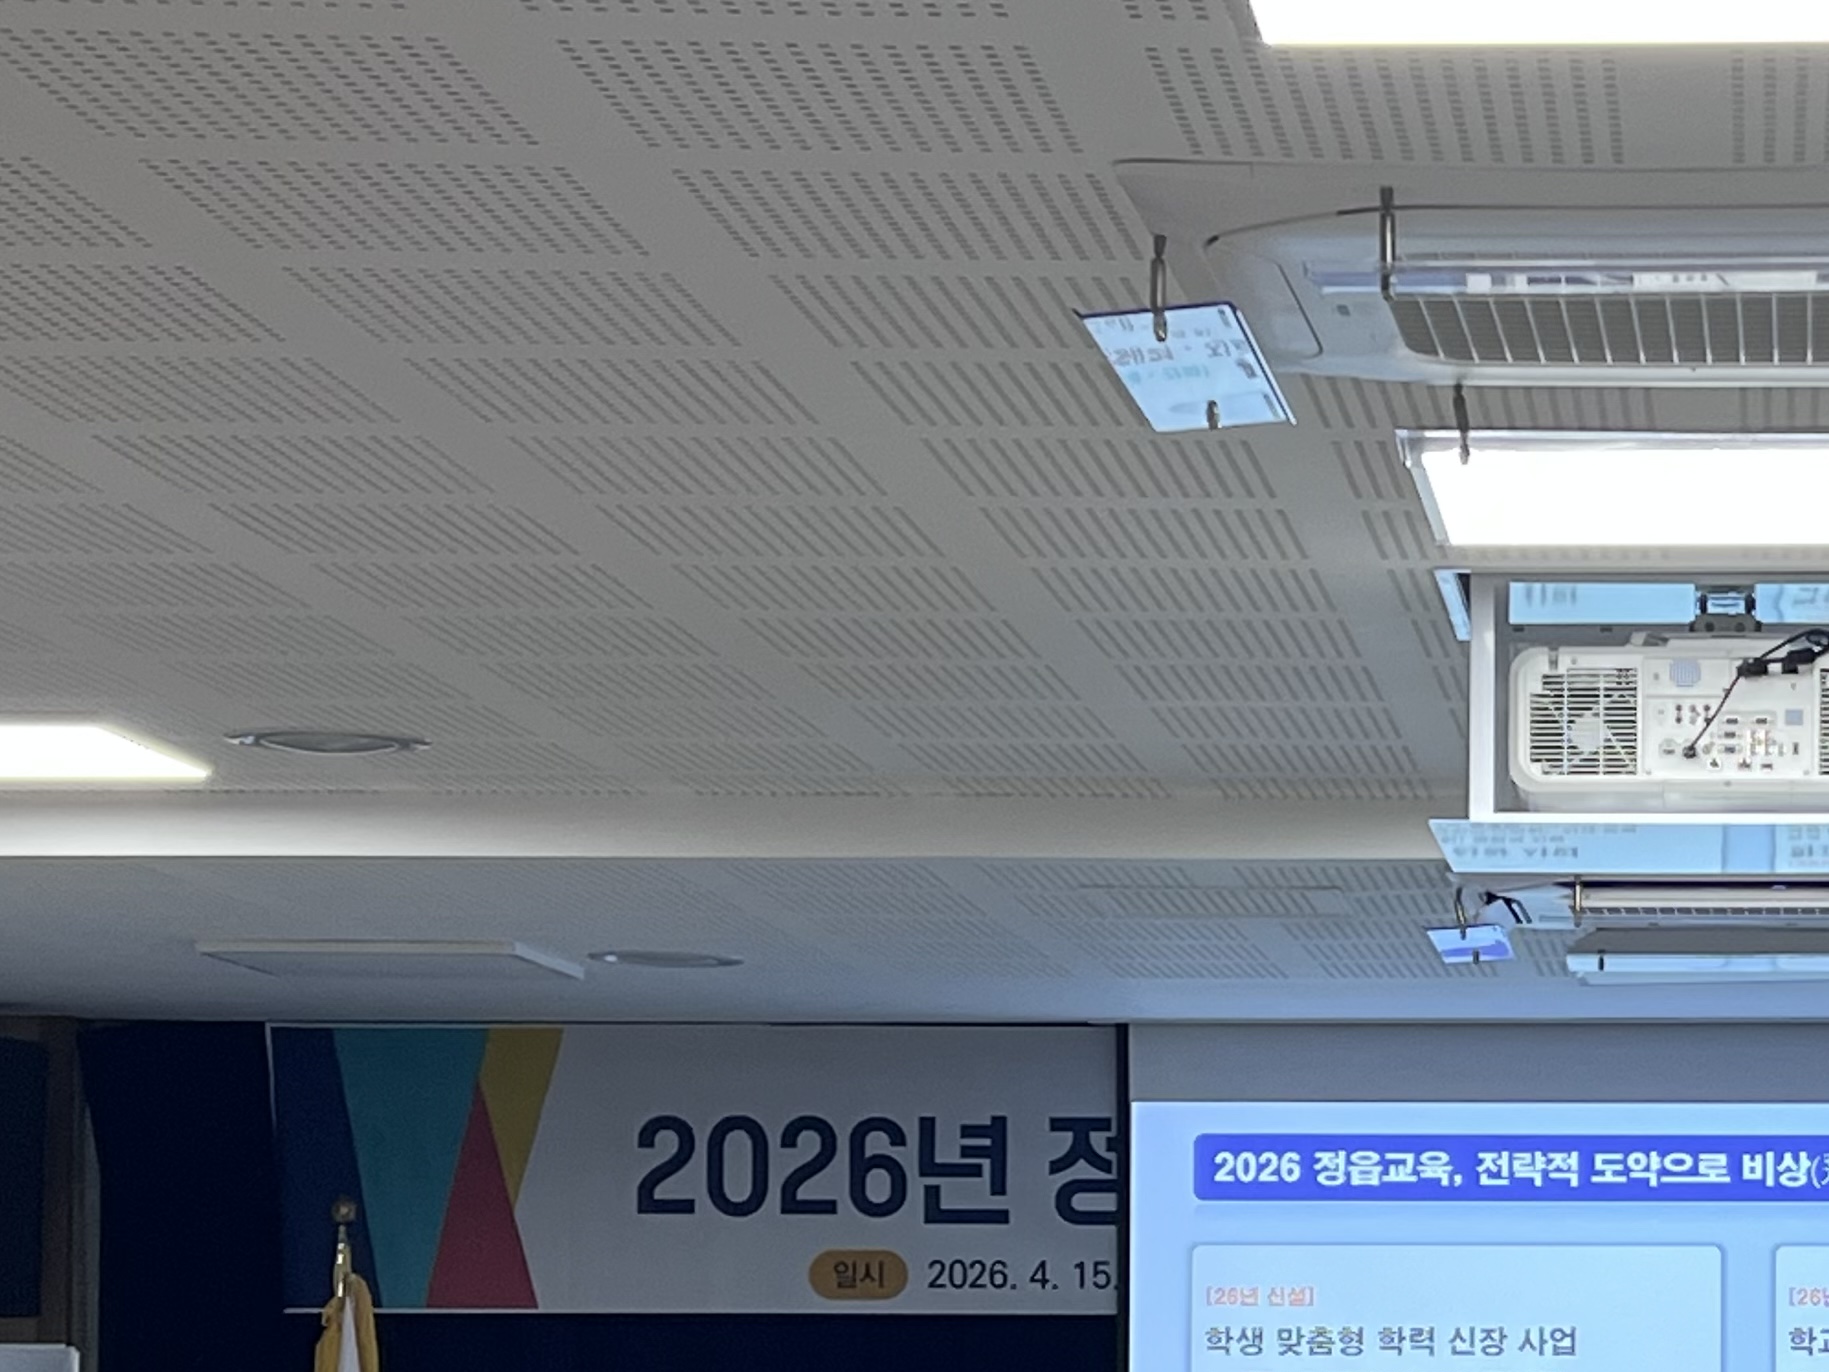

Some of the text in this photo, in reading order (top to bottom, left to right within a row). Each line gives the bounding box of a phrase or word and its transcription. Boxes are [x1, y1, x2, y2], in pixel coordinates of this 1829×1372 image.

[635, 1113, 1009, 1226] 2026년
[1213, 1150, 1300, 1184] 2026
[1312, 1150, 1463, 1188] 정읍교육,
[1475, 1150, 1579, 1188] 전략적
[1590, 1150, 1731, 1188] 도약으로
[832, 1260, 885, 1290] 일시
[927, 1260, 1018, 1290] 2026.
[1029, 1260, 1058, 1290] 4.
[1205, 1286, 1315, 1308] [26년 신설]
[1205, 1326, 1577, 1357] 학생 맞춤형 학력 신장 사업
